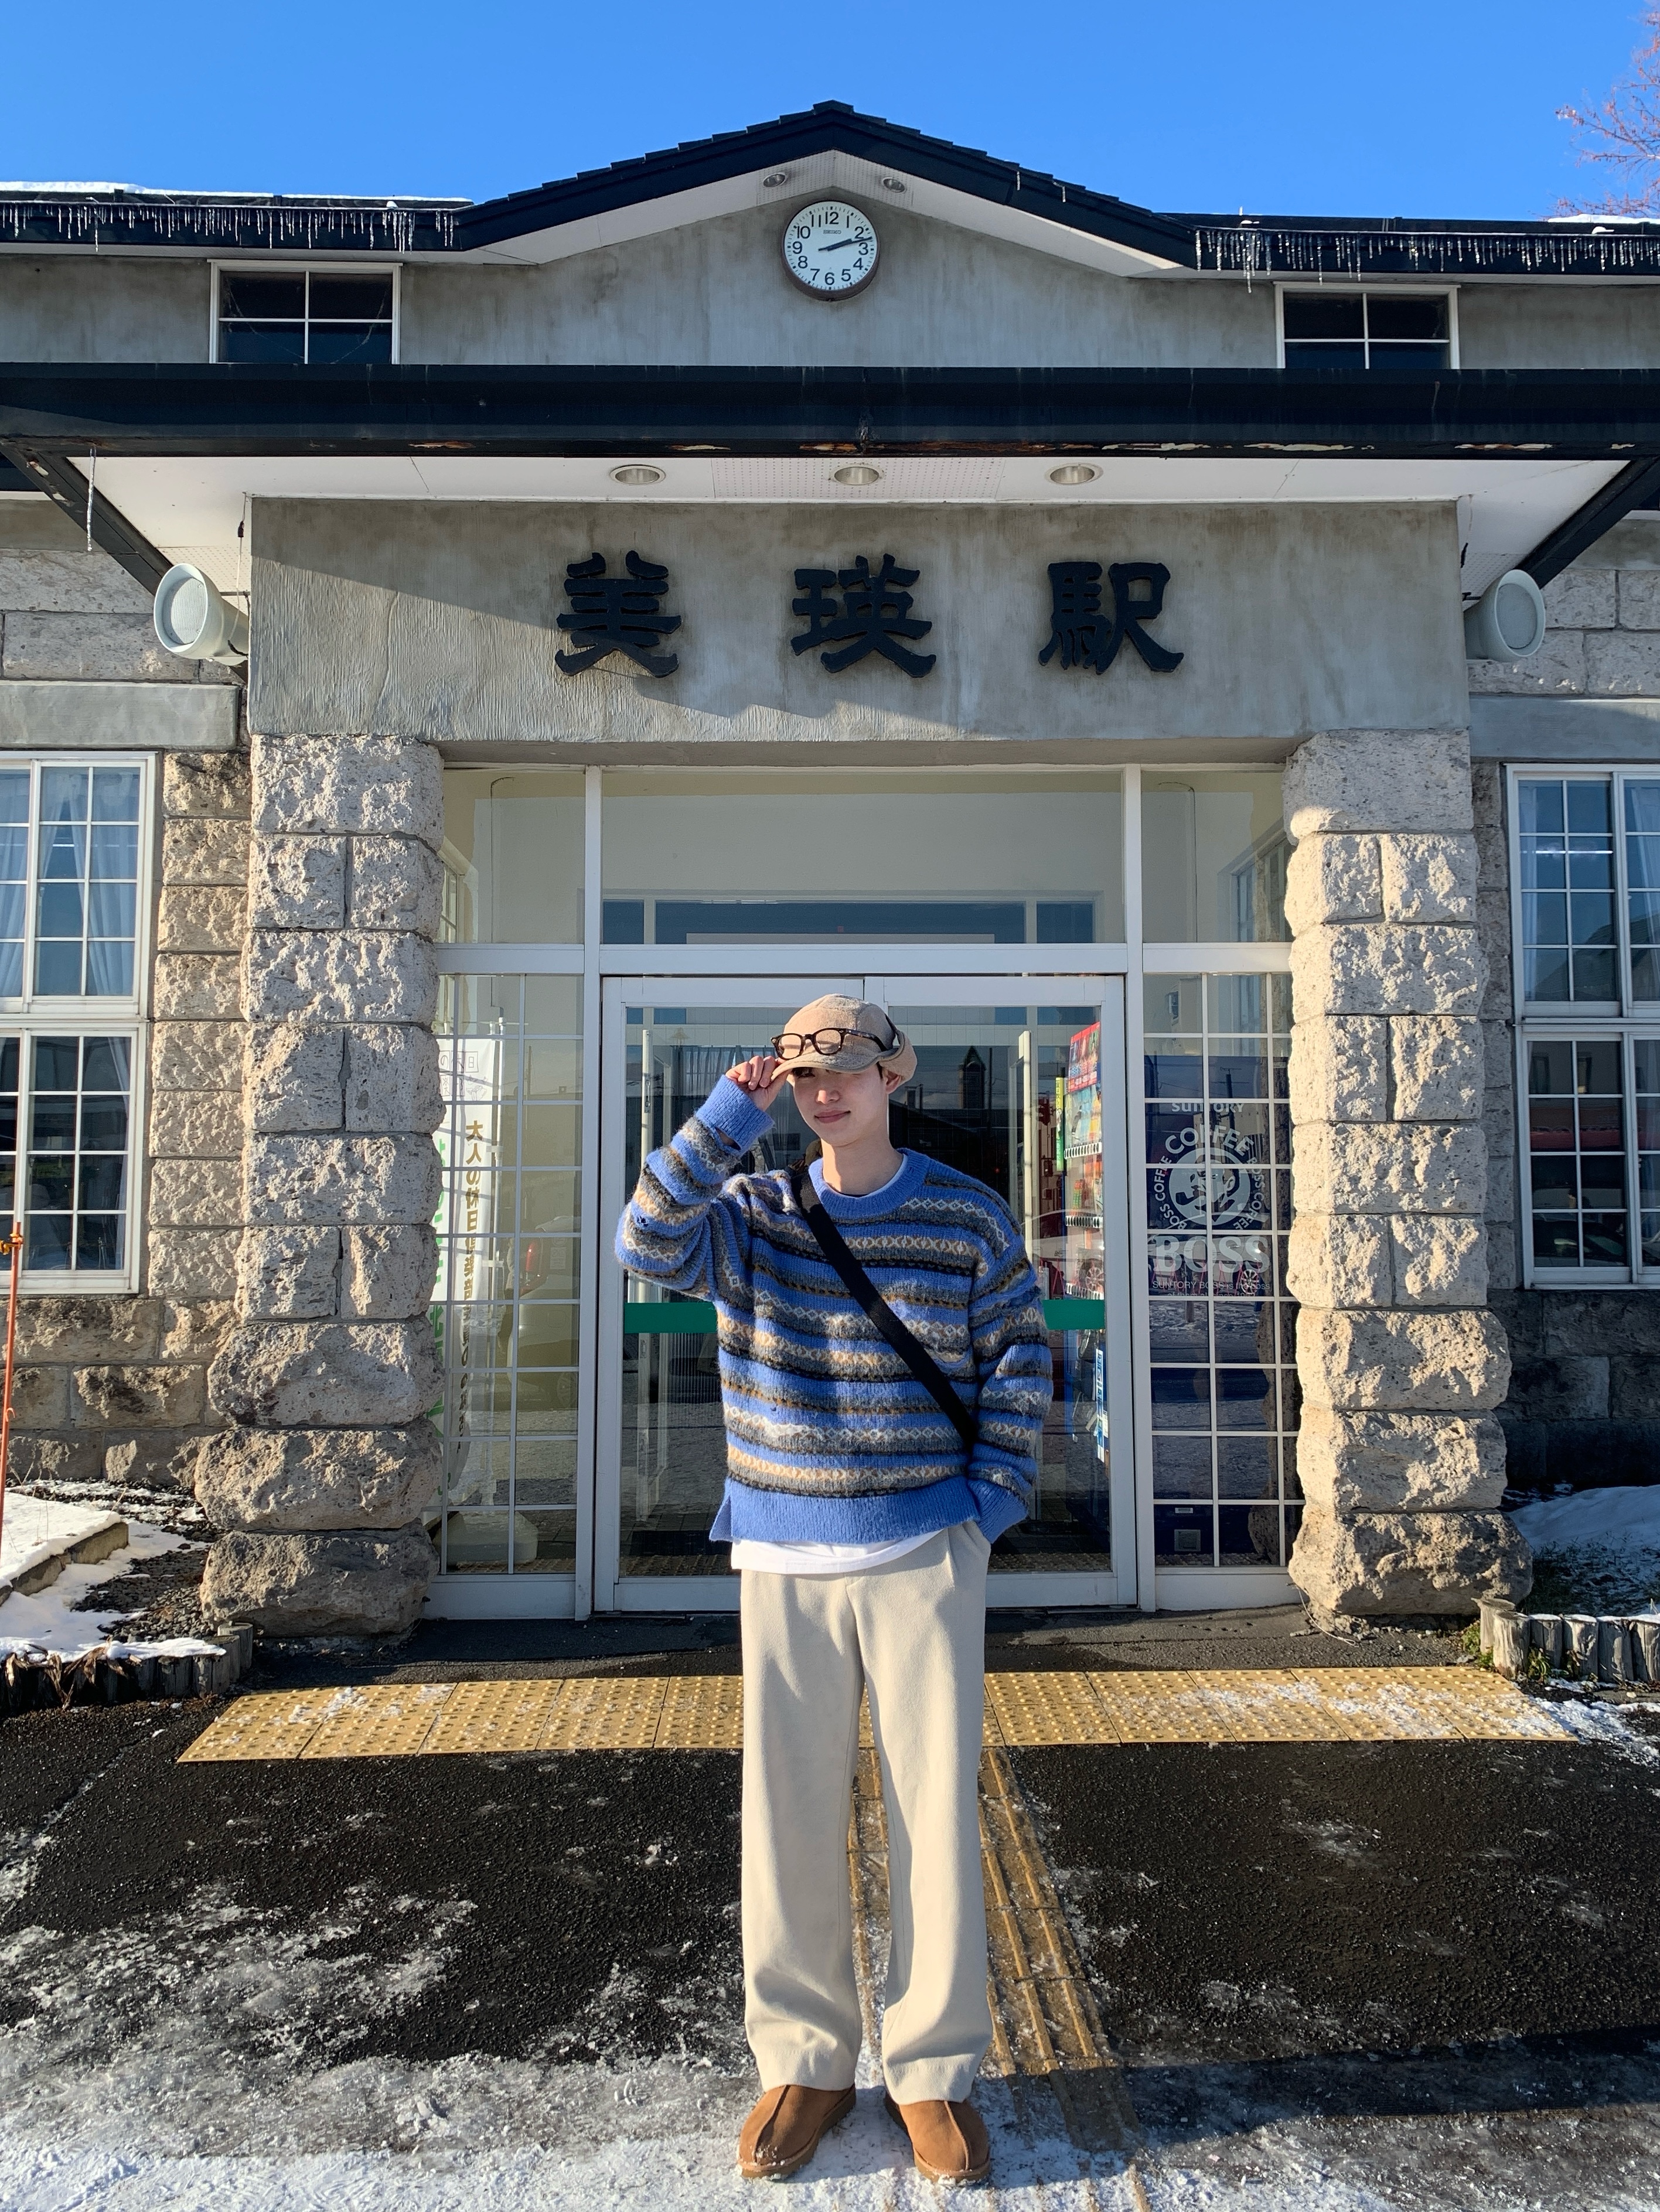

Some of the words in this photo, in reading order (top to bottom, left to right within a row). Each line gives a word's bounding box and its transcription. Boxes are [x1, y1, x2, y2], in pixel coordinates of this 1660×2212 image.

[812, 214, 822, 227] 11
[825, 211, 838, 224] 12
[847, 215, 850, 228] 1
[797, 226, 810, 239] 10
[854, 227, 864, 239] 2
[793, 241, 803, 254] 9
[858, 243, 868, 255] 3
[797, 255, 807, 269] 8
[853, 258, 863, 270] 4
[810, 268, 820, 281] 7
[824, 272, 834, 285] 6
[841, 269, 851, 282] 5
[554, 549, 1185, 678] 美瑛駅
[1153, 1235, 1270, 1274] BOSS
[1153, 1281, 1197, 1289] SUNTORY
